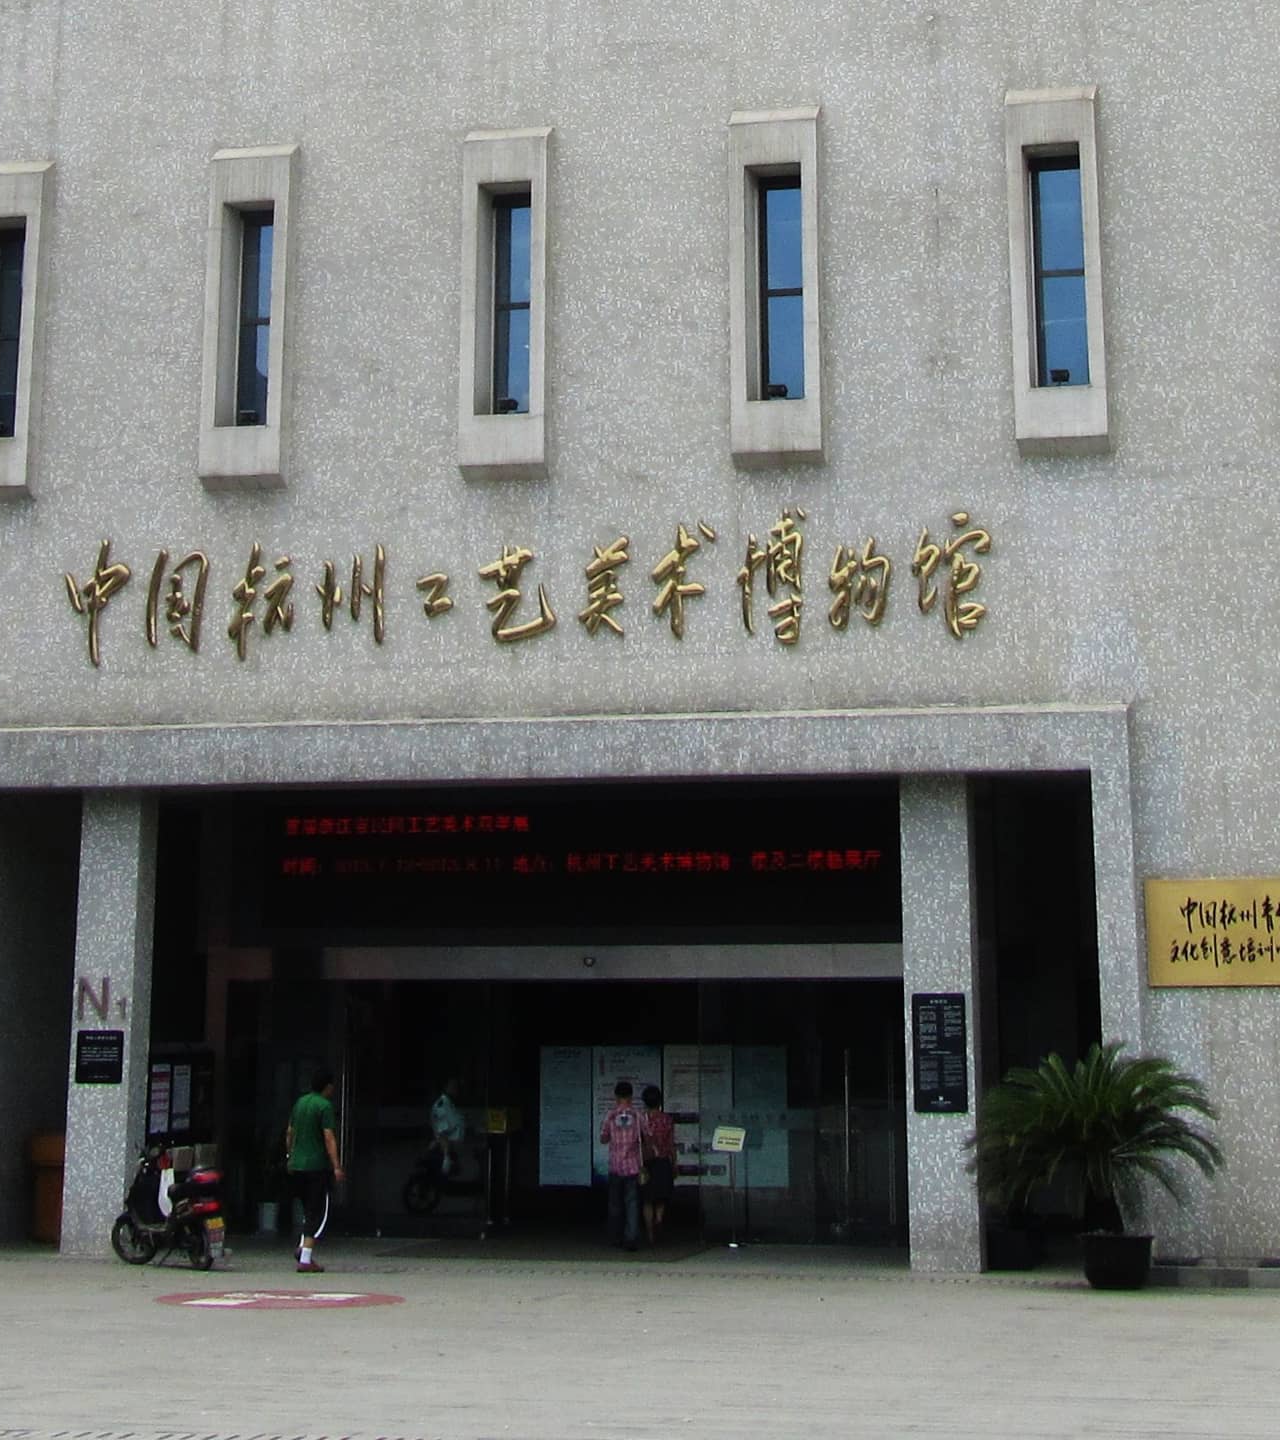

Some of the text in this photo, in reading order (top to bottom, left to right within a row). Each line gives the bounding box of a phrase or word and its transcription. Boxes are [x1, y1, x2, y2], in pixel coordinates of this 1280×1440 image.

[65, 506, 992, 667] 中国杭州工艺美术博物馆
